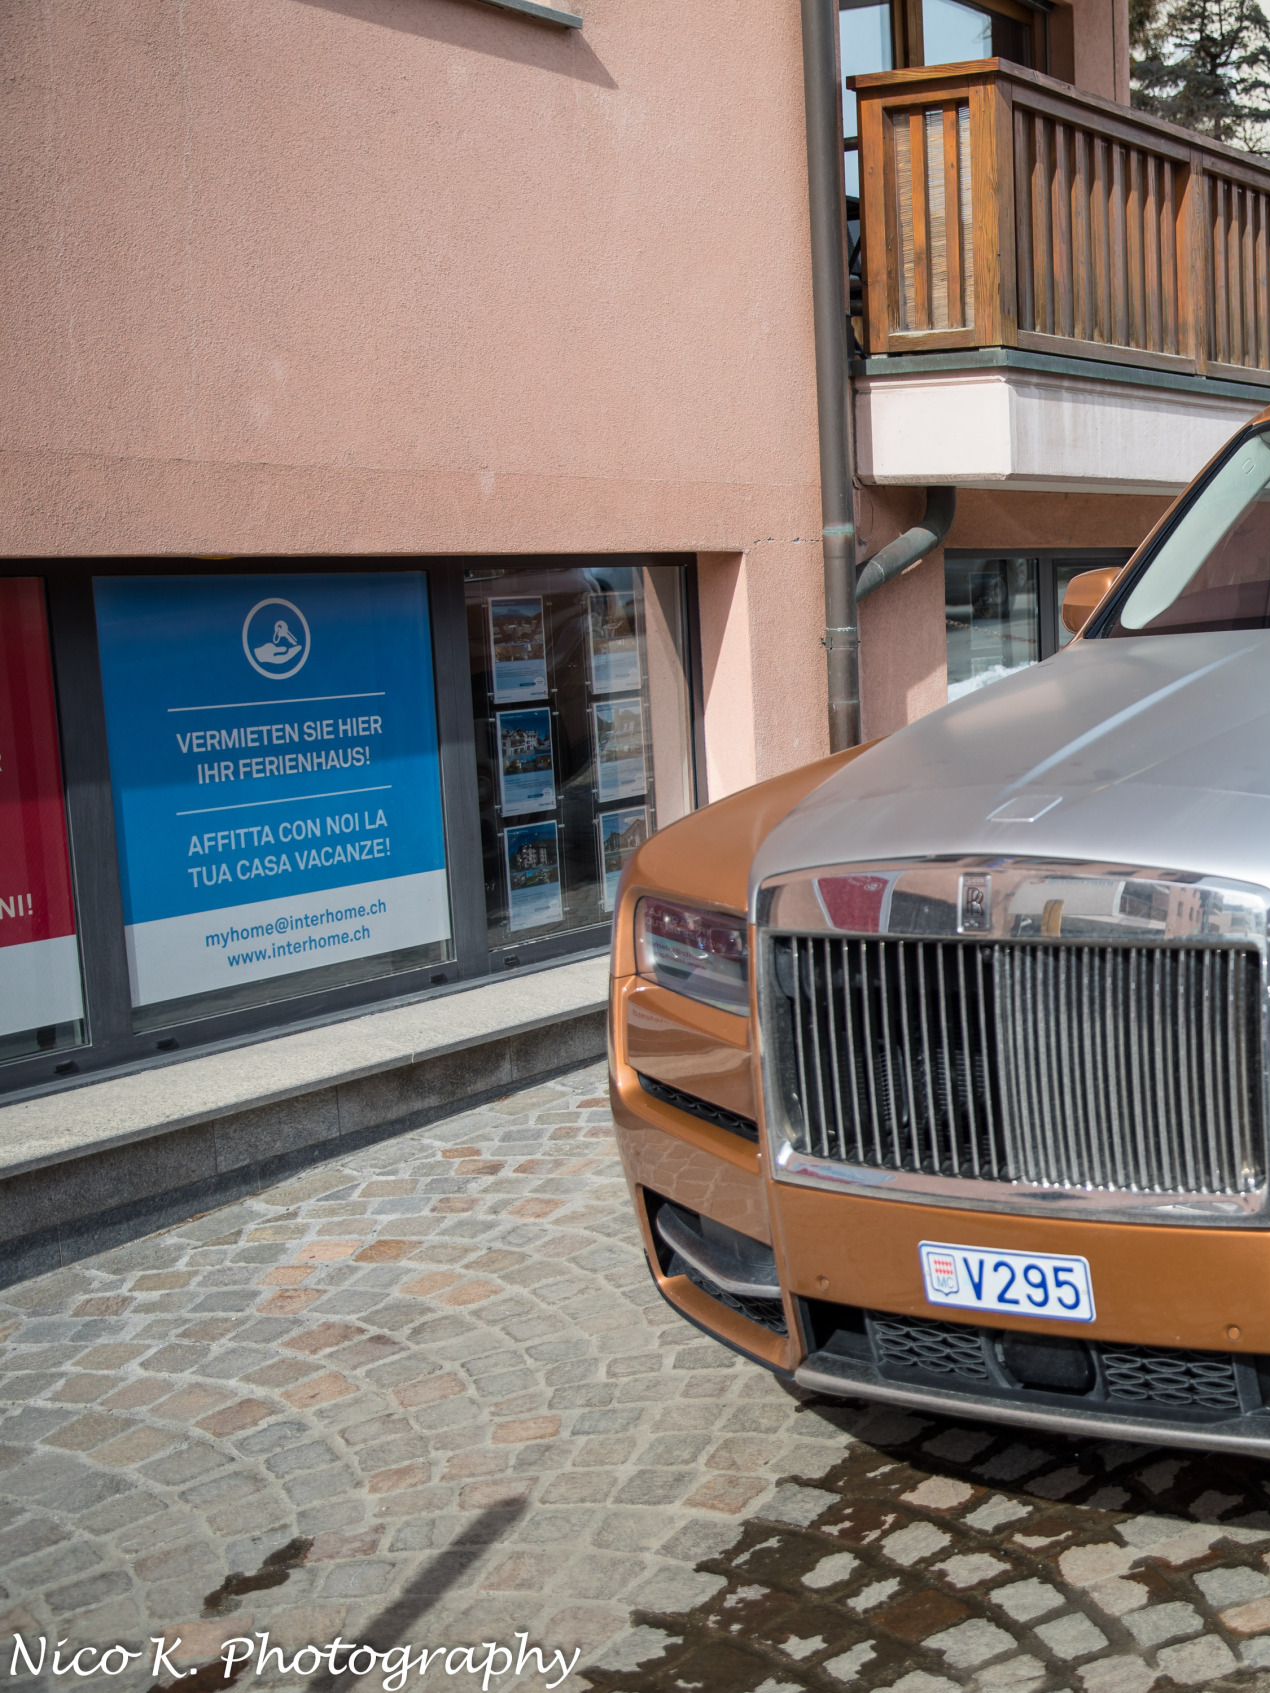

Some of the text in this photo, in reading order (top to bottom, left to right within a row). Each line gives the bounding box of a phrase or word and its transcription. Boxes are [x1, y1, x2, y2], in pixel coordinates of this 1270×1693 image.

[176, 715, 383, 754] VERMIETEN SIE HIER
[197, 746, 371, 785] IHR FERIENHAUS!
[187, 809, 388, 857] AFFITTA CON NOI LA
[187, 837, 391, 888] TUA CASA VACANZE!
[205, 899, 387, 949] myhome@interhome.ch
[227, 925, 371, 967] www.interhome.ch
[936, 1256, 1081, 1311] MC V295
